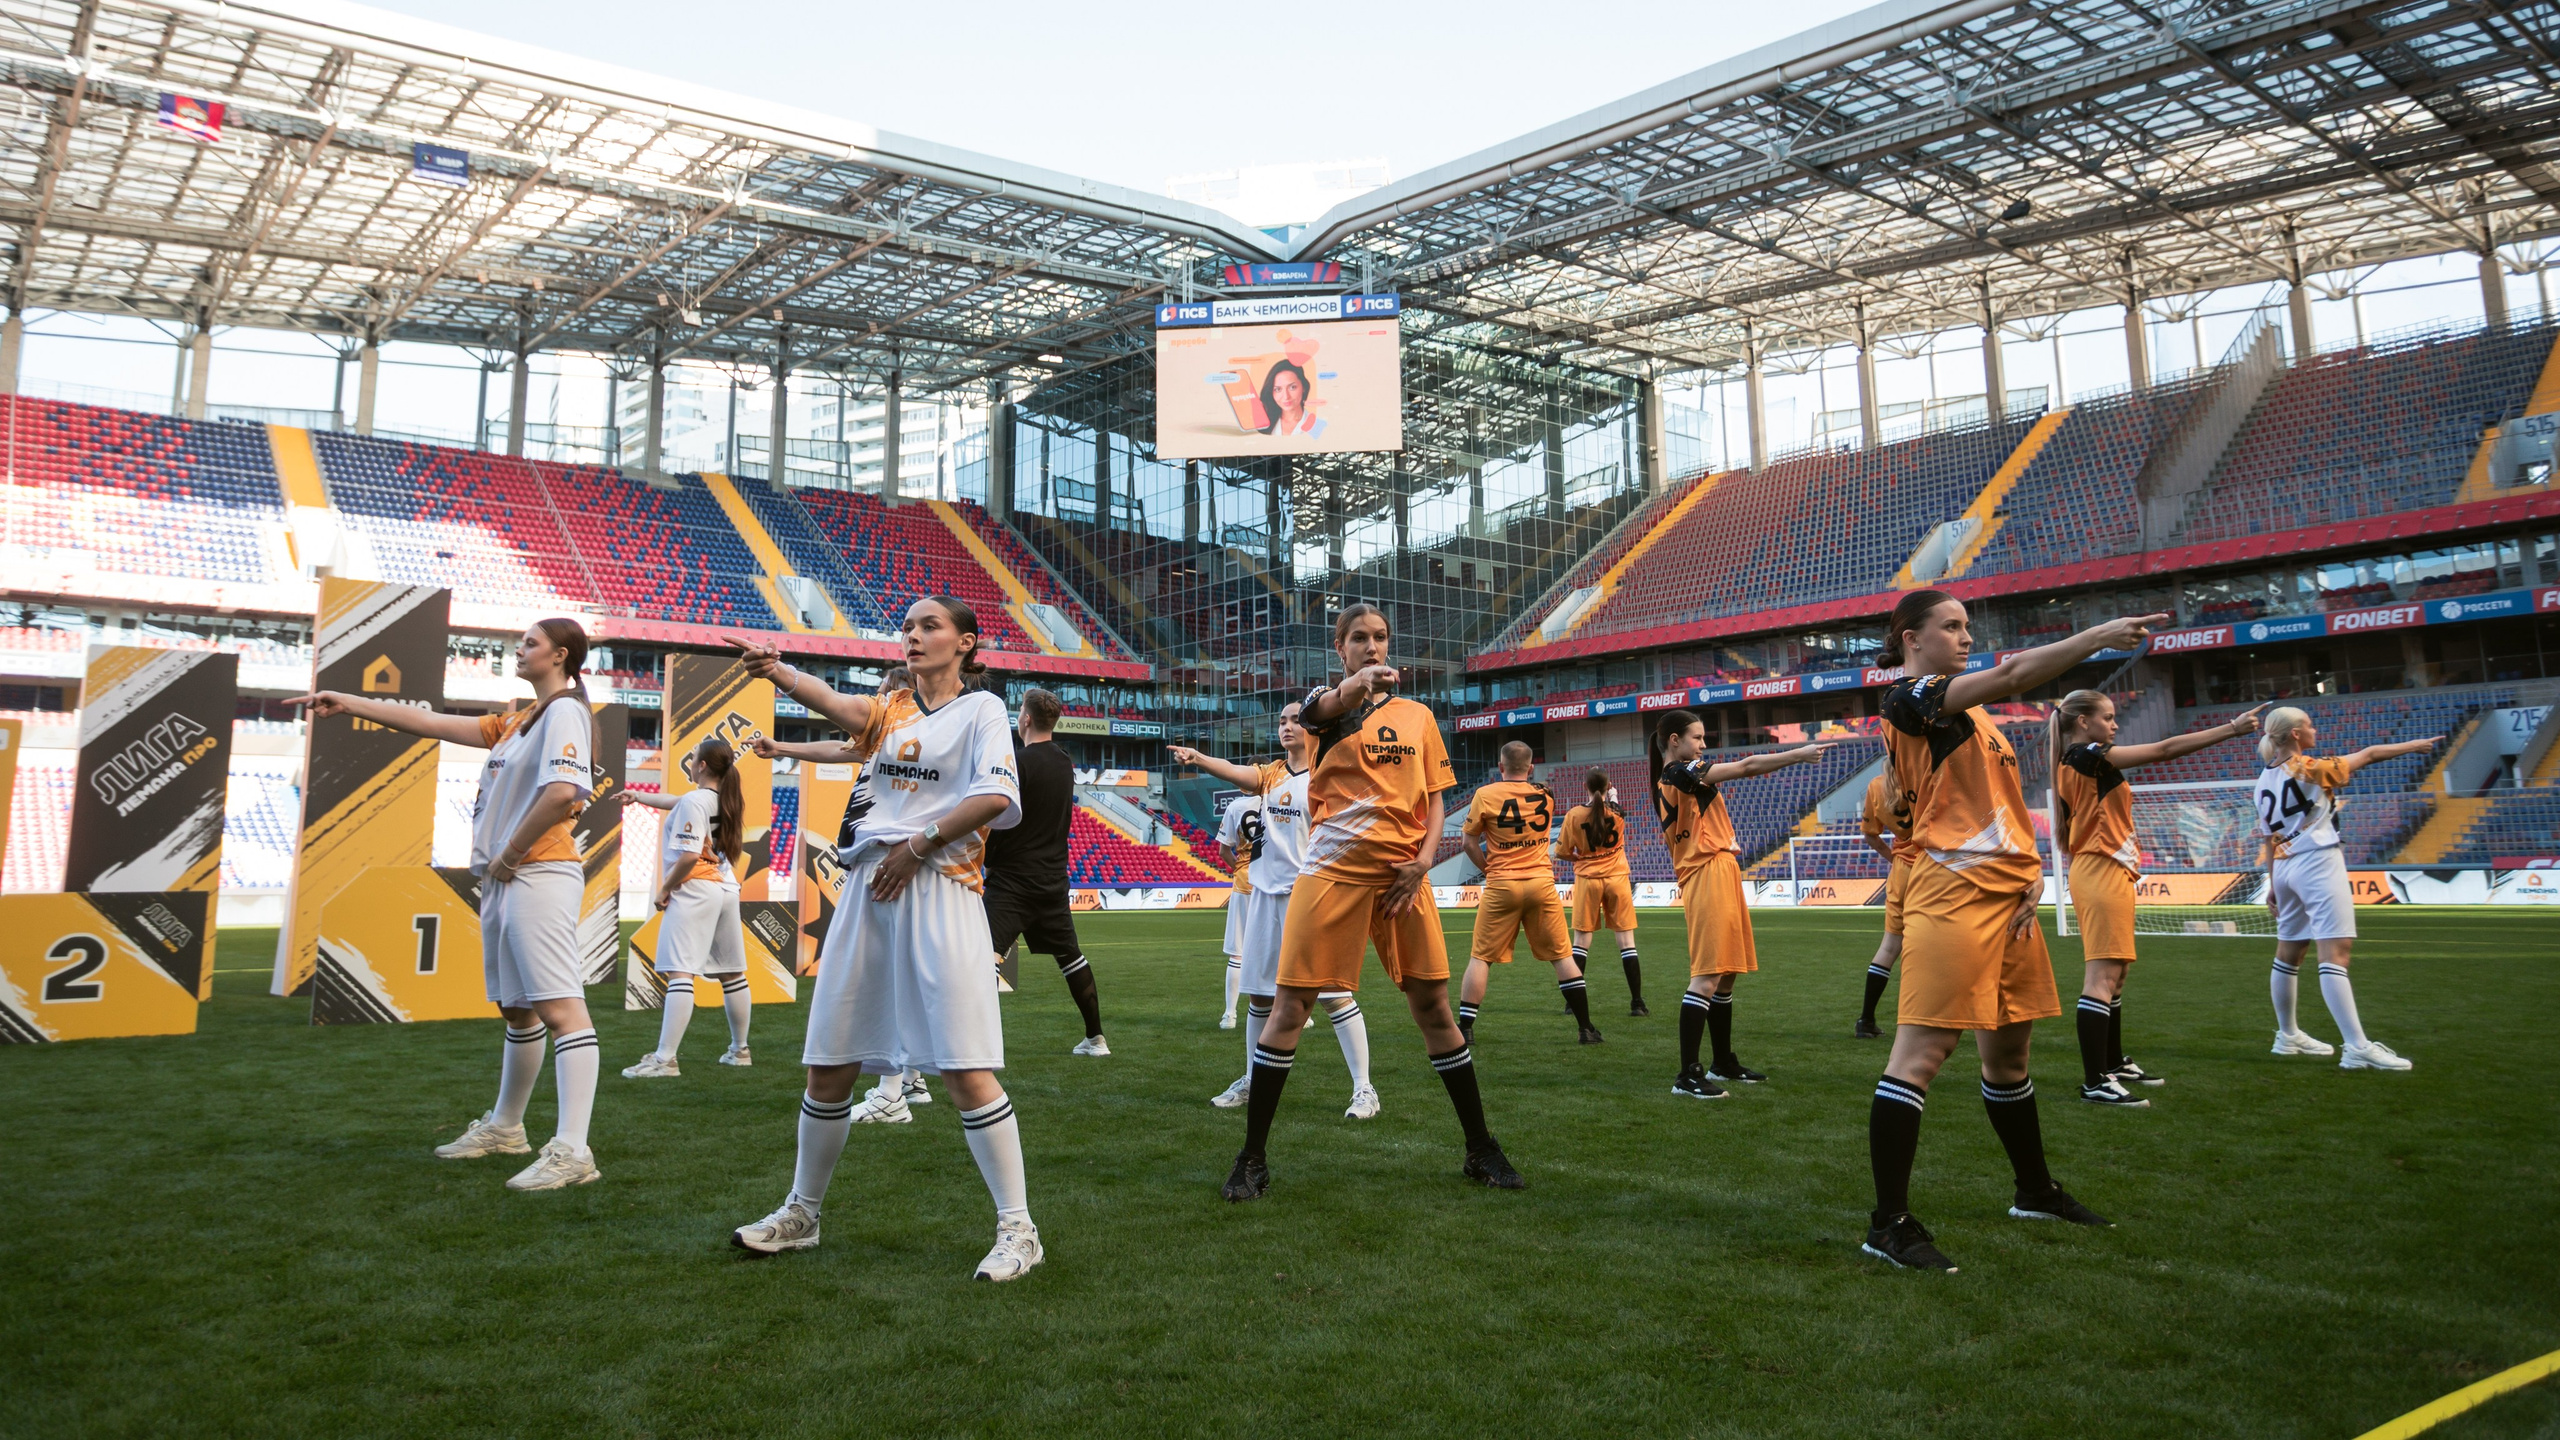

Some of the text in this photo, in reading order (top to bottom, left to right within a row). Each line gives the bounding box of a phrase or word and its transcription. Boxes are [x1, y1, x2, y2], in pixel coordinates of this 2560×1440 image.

[1216, 302, 1338, 318] БАНК ЧЕМПИОНОВ
[1365, 298, 1393, 311] ПСБ
[1179, 307, 1208, 319] ПСБ
[2463, 599, 2513, 613] РОССЕТИ
[2332, 606, 2420, 631] FONBET
[2269, 622, 2311, 634] РОССЕТИ
[2153, 628, 2227, 650] FONBET
[1825, 676, 1851, 685] РОССЕТИ
[1866, 666, 1904, 684] FONB
[1710, 689, 1735, 698] РОССЕТИ
[1746, 679, 1796, 697] FONBET
[1605, 702, 1628, 710] РОССЕТИ
[1640, 692, 1685, 708] FONBET
[1516, 712, 1536, 720] РОССЕТИ
[1546, 704, 1587, 719] FONBET
[1065, 722, 1106, 731] APOTHEKA
[1460, 715, 1496, 729] FONBET
[1365, 744, 1416, 756] ЛЕМАНА
[91, 712, 207, 805] ЛИГА
[1376, 755, 1402, 765] ПРО
[549, 759, 589, 774] ЛЕМАНА
[557, 766, 578, 777] ПРО
[878, 763, 940, 782] ЛЕМАНА
[116, 736, 218, 817] ЛЕМАНА ПРО
[891, 778, 919, 793] ПРО
[1267, 806, 1301, 817] ЛЕМАНА
[2260, 777, 2315, 833] 24
[1274, 815, 1291, 824] ПРО
[1497, 793, 1550, 835] 43
[1498, 837, 1549, 849] ЛЕМАНА ПР
[1455, 891, 1479, 901] ЛИГА
[1558, 890, 1573, 900] ЛИ
[1802, 887, 1836, 899] ЛИГА
[2136, 883, 2171, 896] ИГА
[1069, 894, 1095, 905] ЛИГА
[1176, 893, 1202, 903] ЛИГА
[142, 903, 193, 948] ЛИГА
[756, 909, 790, 947] ЛИГА
[413, 913, 441, 974] 1
[43, 933, 107, 1003] 2
